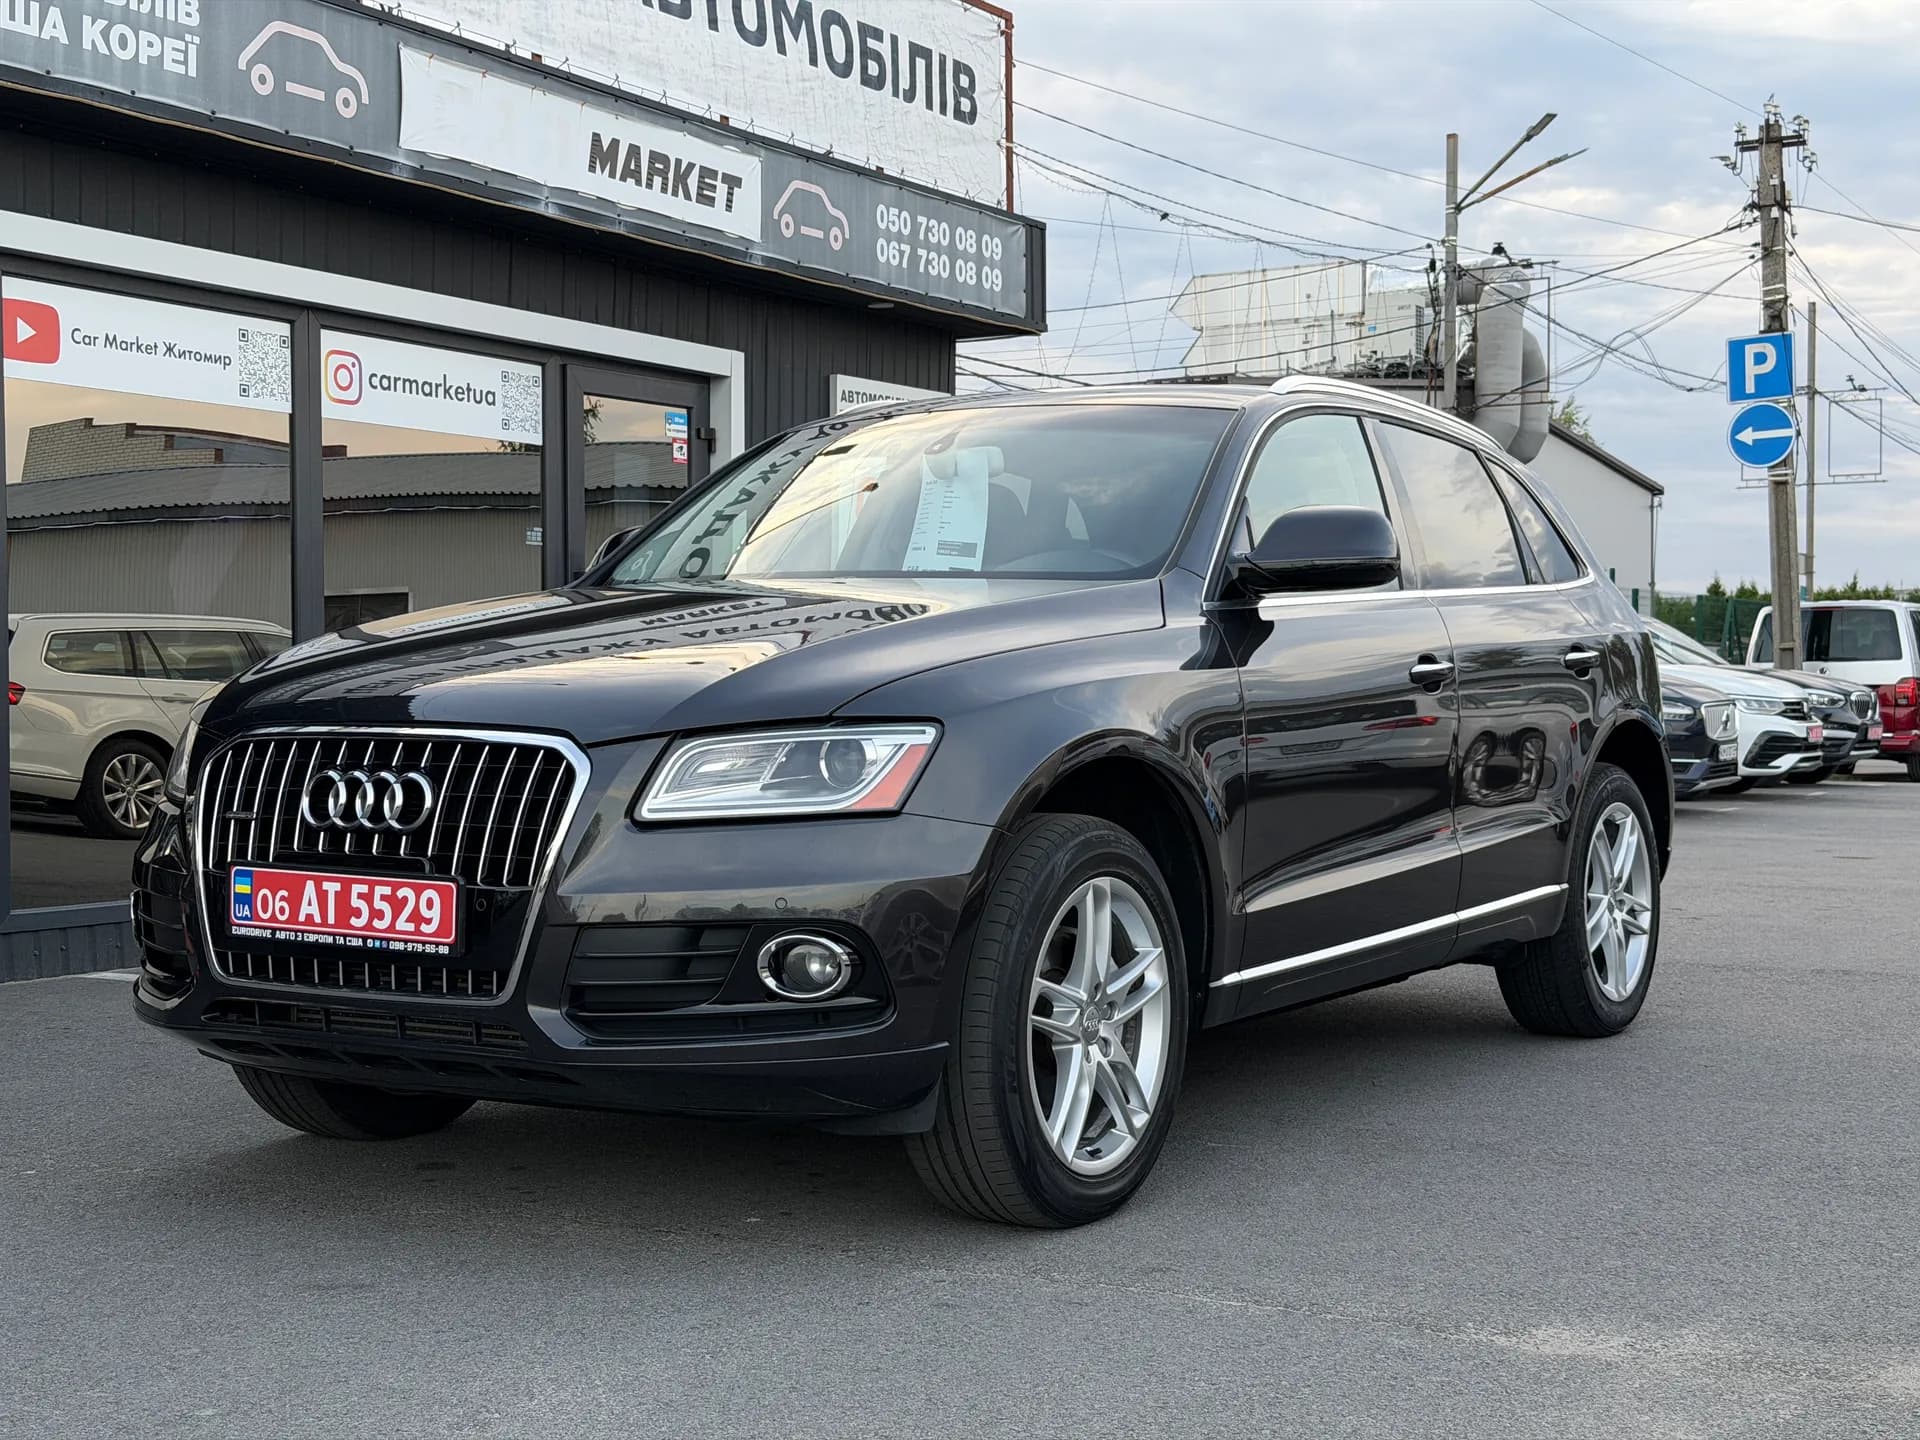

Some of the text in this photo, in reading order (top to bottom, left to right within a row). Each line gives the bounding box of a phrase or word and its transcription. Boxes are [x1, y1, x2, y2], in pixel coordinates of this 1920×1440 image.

[82, 14, 200, 78] КОРЕЇ
[640, 0, 978, 125] ОМОБІЛІВ
[588, 131, 742, 213] MARKET
[876, 204, 1002, 261] 050 730 08 09
[876, 238, 1002, 292] 067 730 08 09
[71, 327, 232, 371] Car Market Житомир
[1744, 342, 1777, 394] P
[368, 372, 497, 406] carmarketua
[840, 388, 906, 404] АВТОМ
[235, 904, 251, 918] UA
[256, 888, 290, 921] 06
[350, 883, 441, 934] 5529
[346, 937, 363, 947] США
